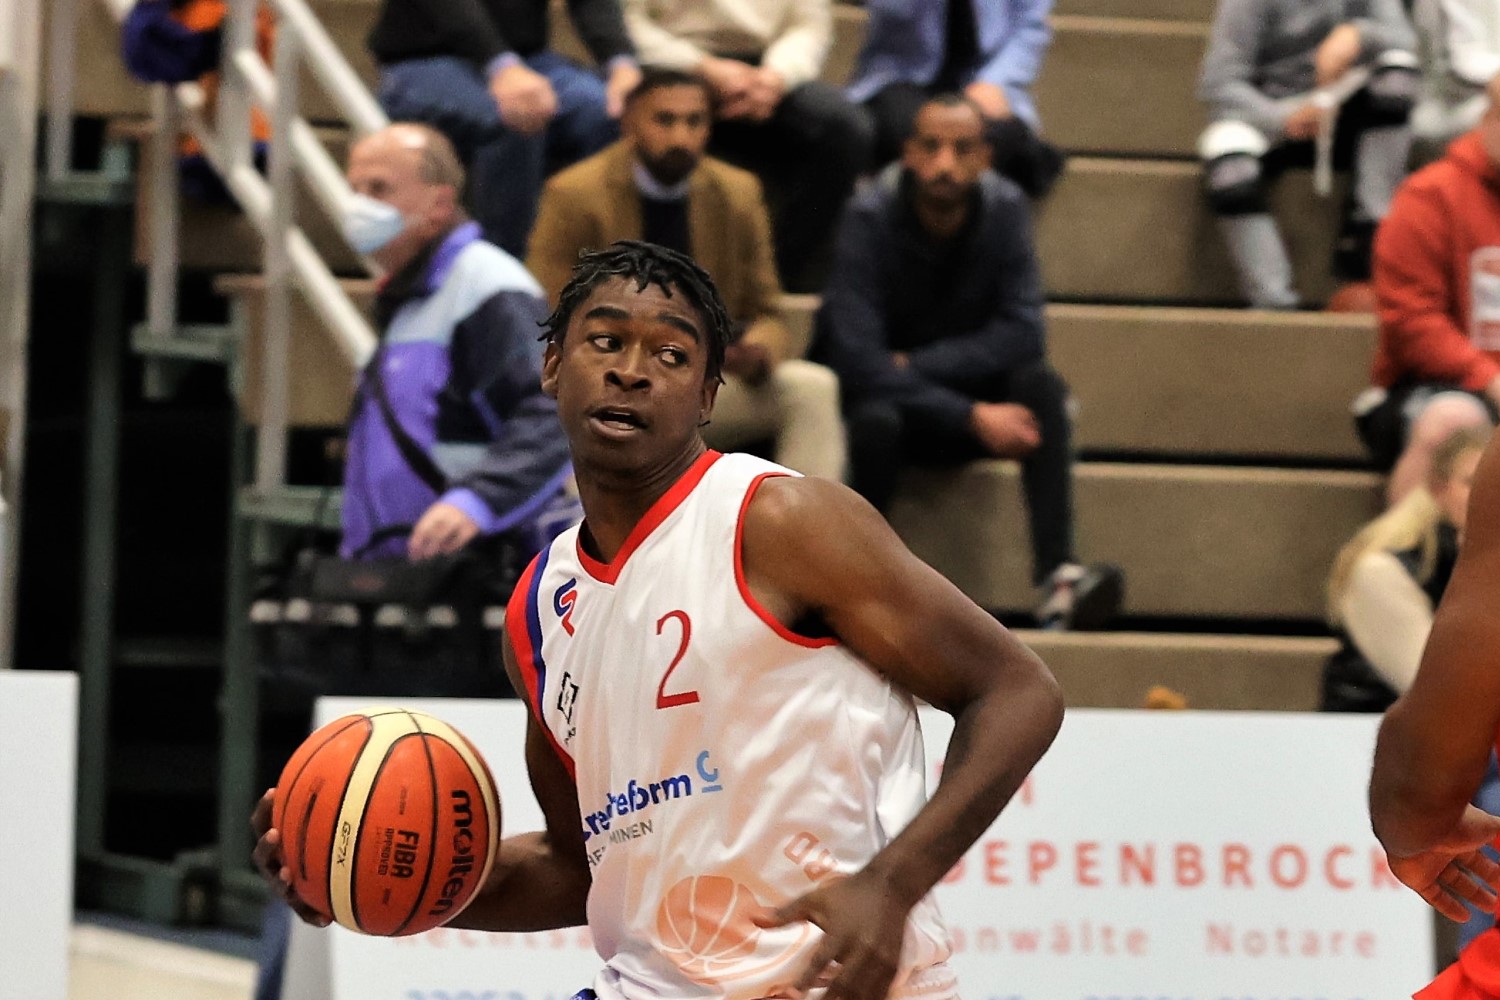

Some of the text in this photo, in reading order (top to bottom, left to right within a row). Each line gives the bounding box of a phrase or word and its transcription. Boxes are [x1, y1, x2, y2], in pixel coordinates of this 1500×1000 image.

[656, 609, 700, 710] 2
[390, 829, 420, 879] FIBA
[428, 789, 474, 917] molten
[1203, 921, 1378, 959] Notare
